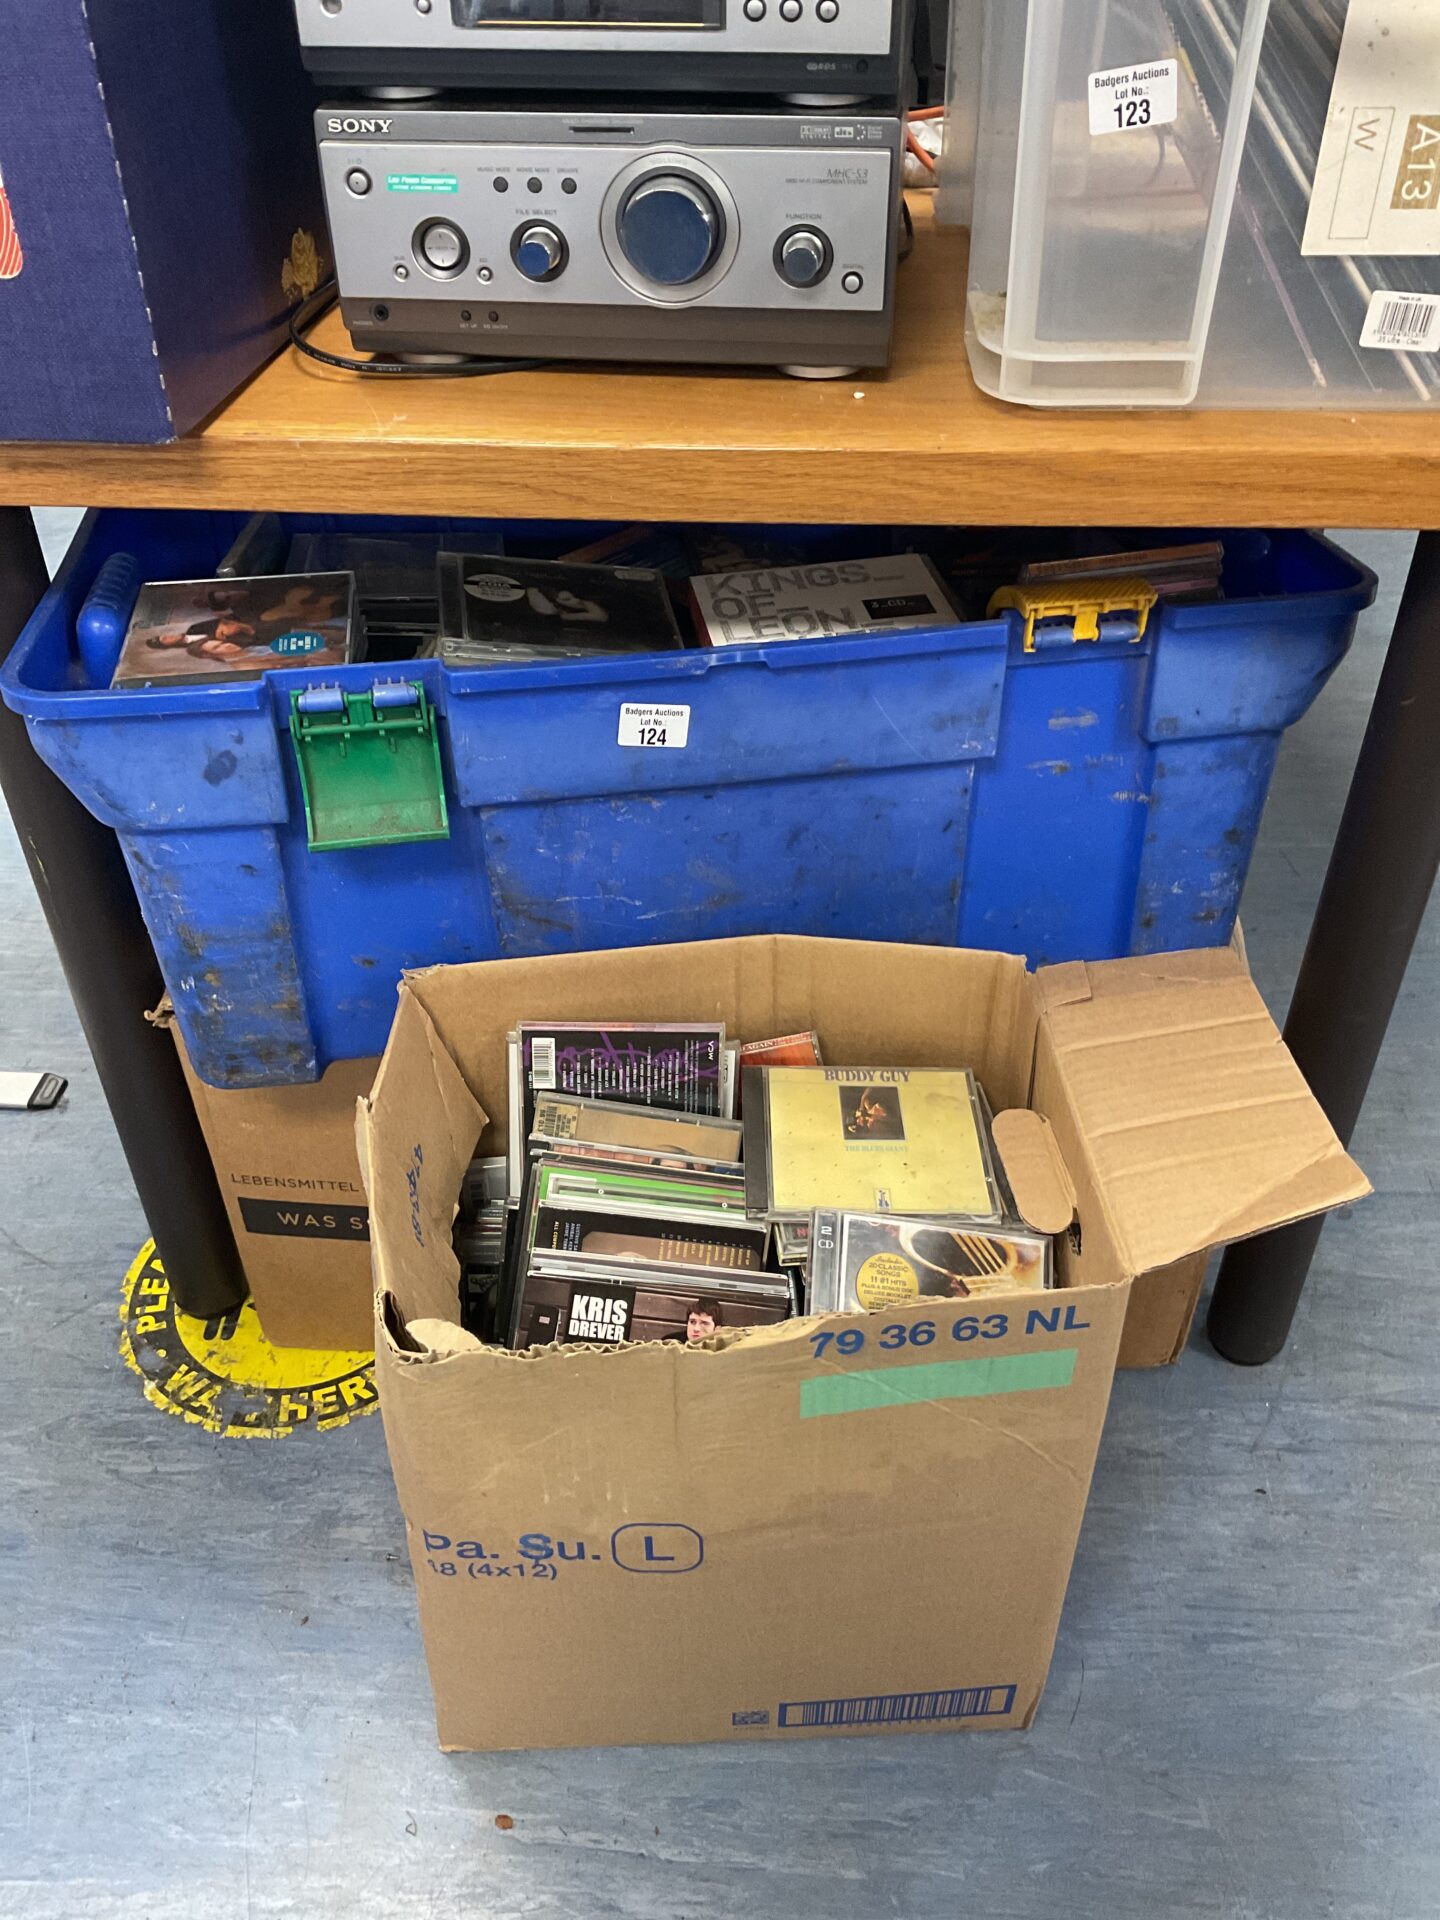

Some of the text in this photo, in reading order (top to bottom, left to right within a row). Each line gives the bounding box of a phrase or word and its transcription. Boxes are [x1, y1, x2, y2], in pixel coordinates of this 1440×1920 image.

[1094, 68, 1169, 88] Badgers Auctions
[1115, 89, 1128, 99] Lot
[1114, 99, 1150, 128] 123
[328, 118, 392, 133] SONY
[1354, 118, 1380, 151] W
[626, 708, 684, 716] Badgers Auctions
[638, 728, 666, 745] 124
[824, 1069, 911, 1082] BUDDY GUY
[231, 1174, 359, 1192] LEBENSMITTEL
[276, 1212, 336, 1228] WAS
[821, 1226, 832, 1235] 2
[818, 1239, 834, 1249] CD
[572, 1295, 628, 1324] KRIS
[569, 1322, 624, 1340] DREVER
[879, 1321, 936, 1349] 36
[952, 1314, 1008, 1342] 63
[1025, 1305, 1090, 1335] NL
[516, 1532, 601, 1561] Su.
[644, 1536, 674, 1561] L
[468, 1562, 558, 1580] (4x12)
